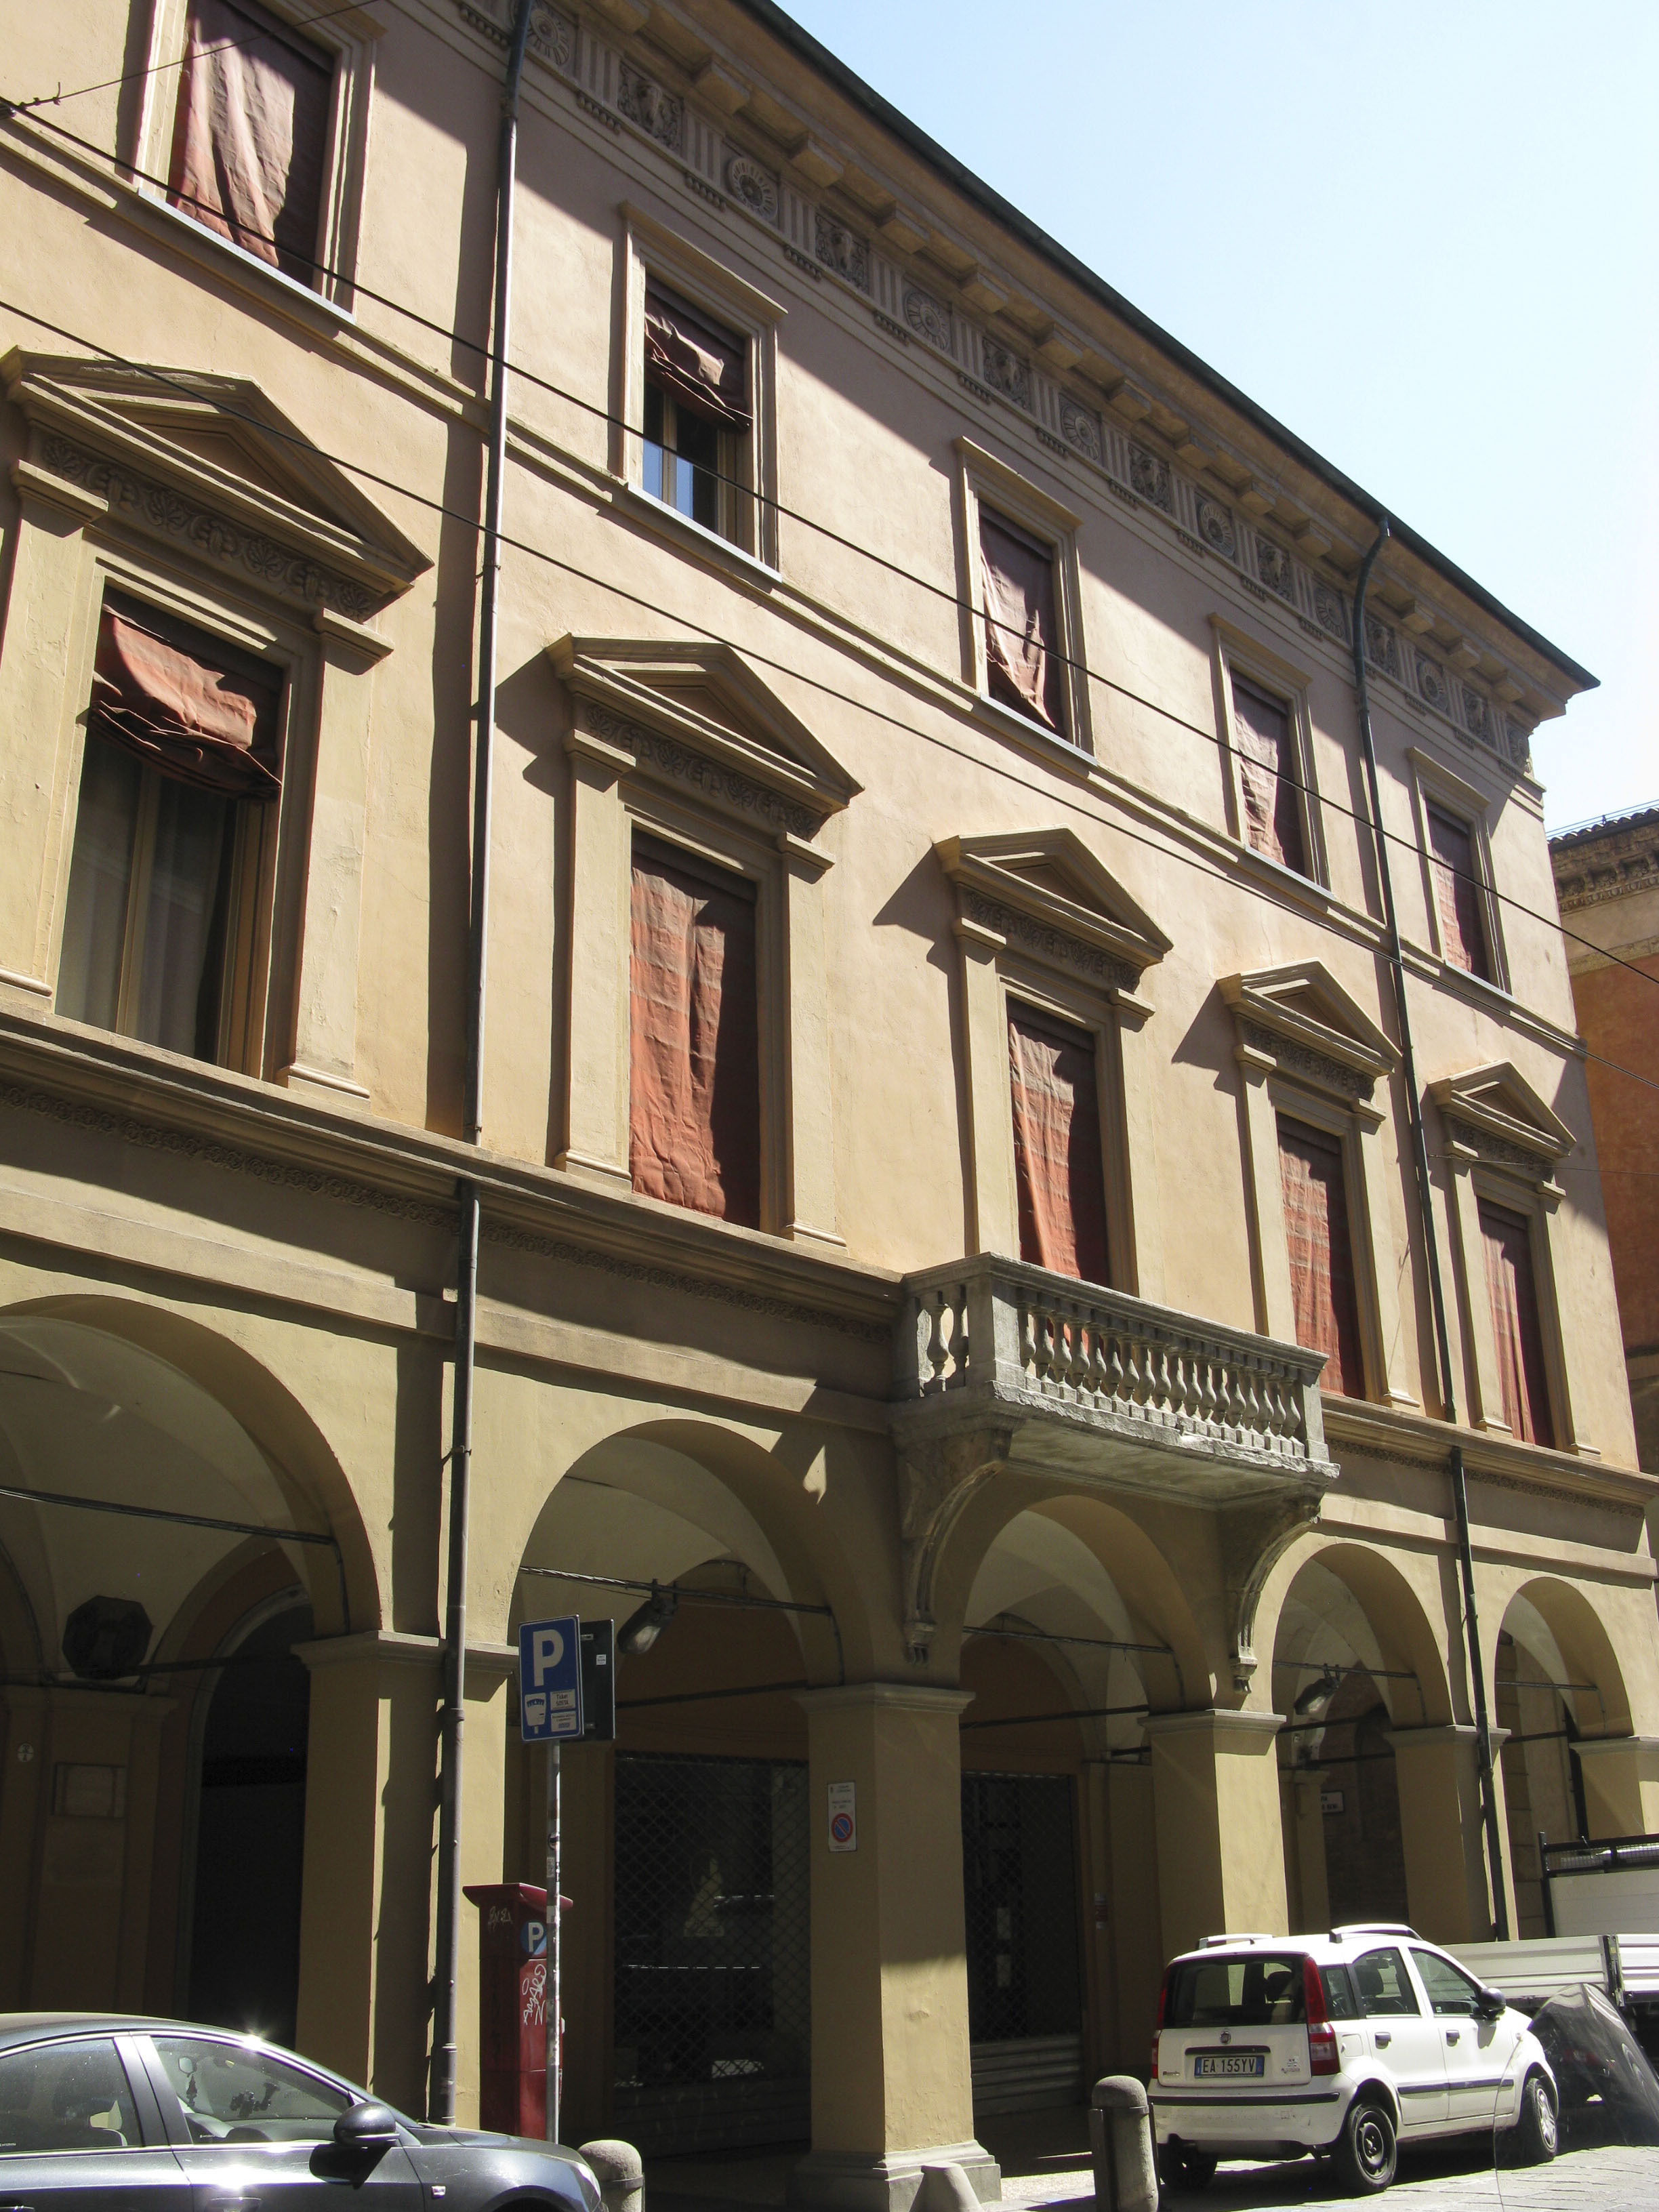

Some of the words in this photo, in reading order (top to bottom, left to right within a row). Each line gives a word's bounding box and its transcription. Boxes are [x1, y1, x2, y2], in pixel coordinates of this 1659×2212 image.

[533, 1629, 564, 1687] P
[529, 1923, 544, 1952] P
[1203, 2060, 1216, 2072] EA
[1221, 2058, 1255, 2072] 155YV
